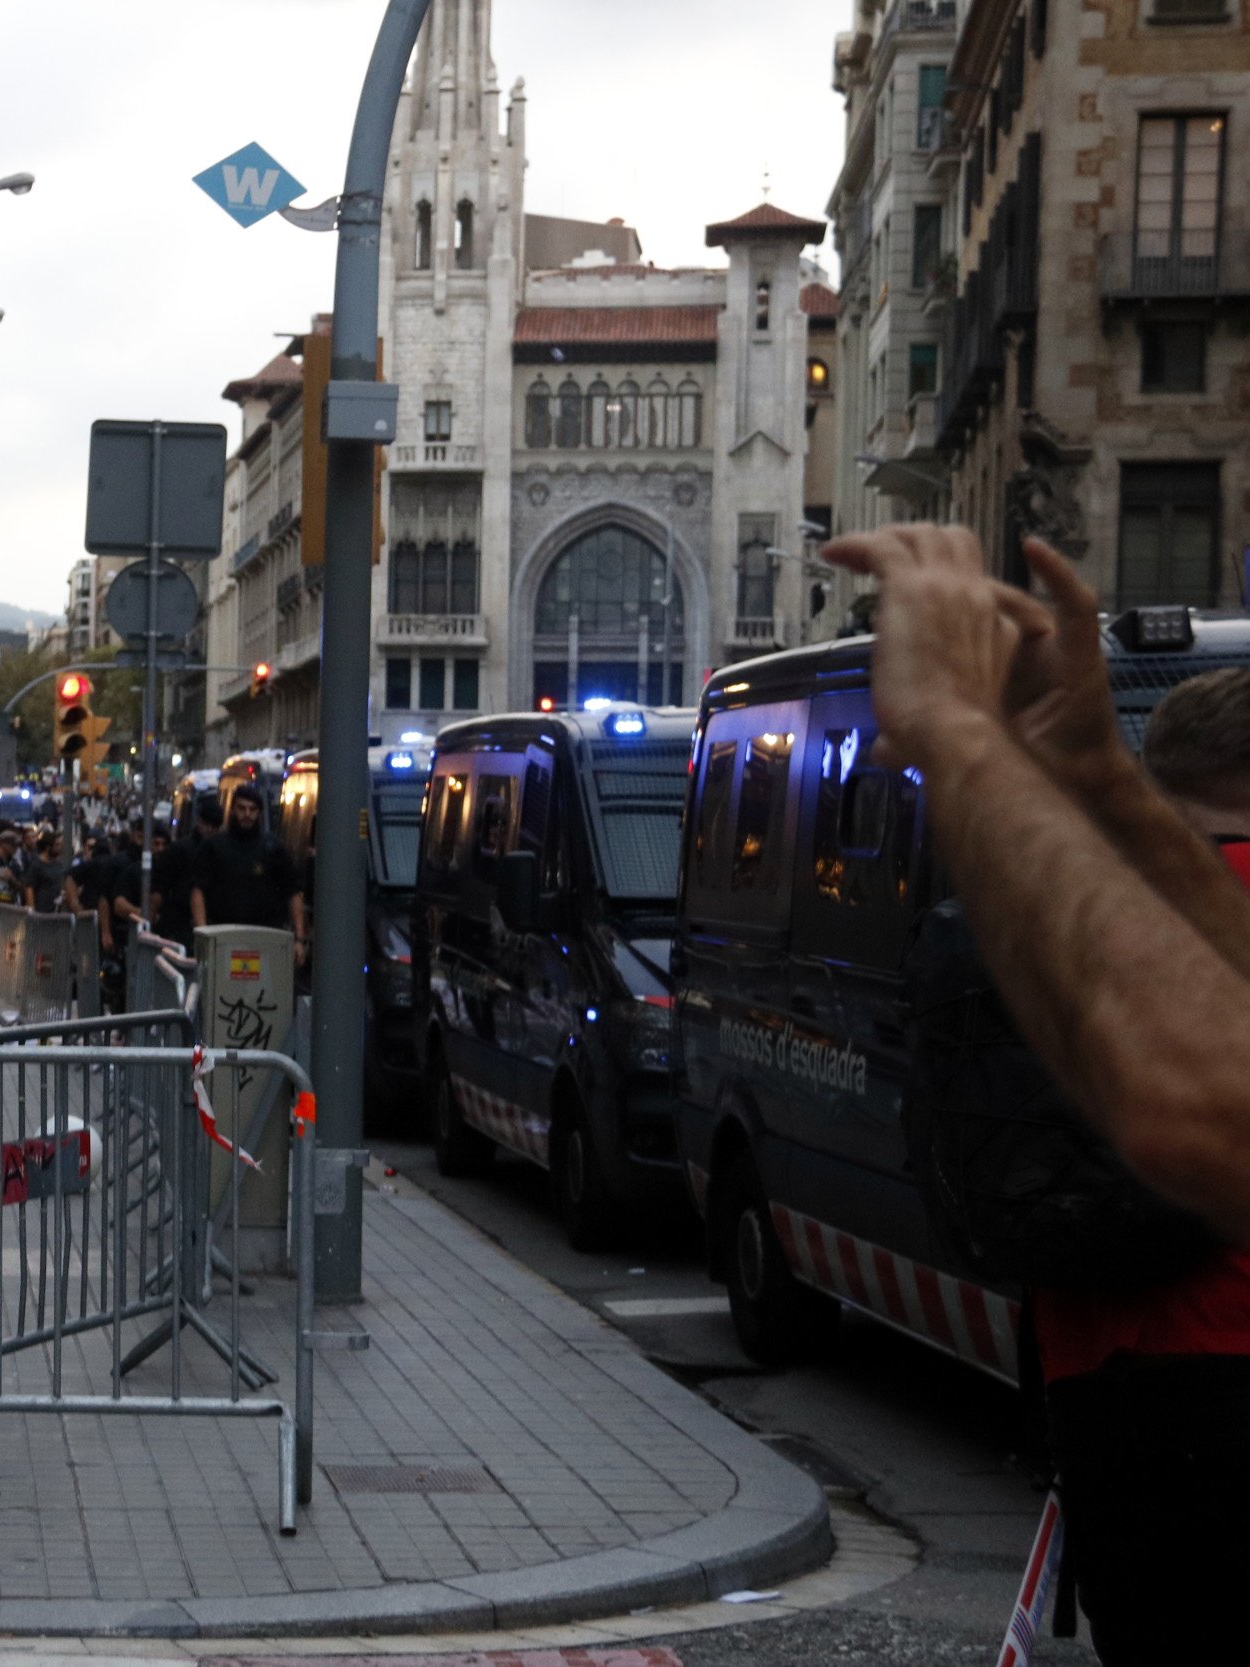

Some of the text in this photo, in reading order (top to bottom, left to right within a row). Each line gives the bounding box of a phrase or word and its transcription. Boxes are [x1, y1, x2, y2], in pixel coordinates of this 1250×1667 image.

[222, 165, 280, 207] W
[719, 1017, 867, 1096] mossos d'esquadra
